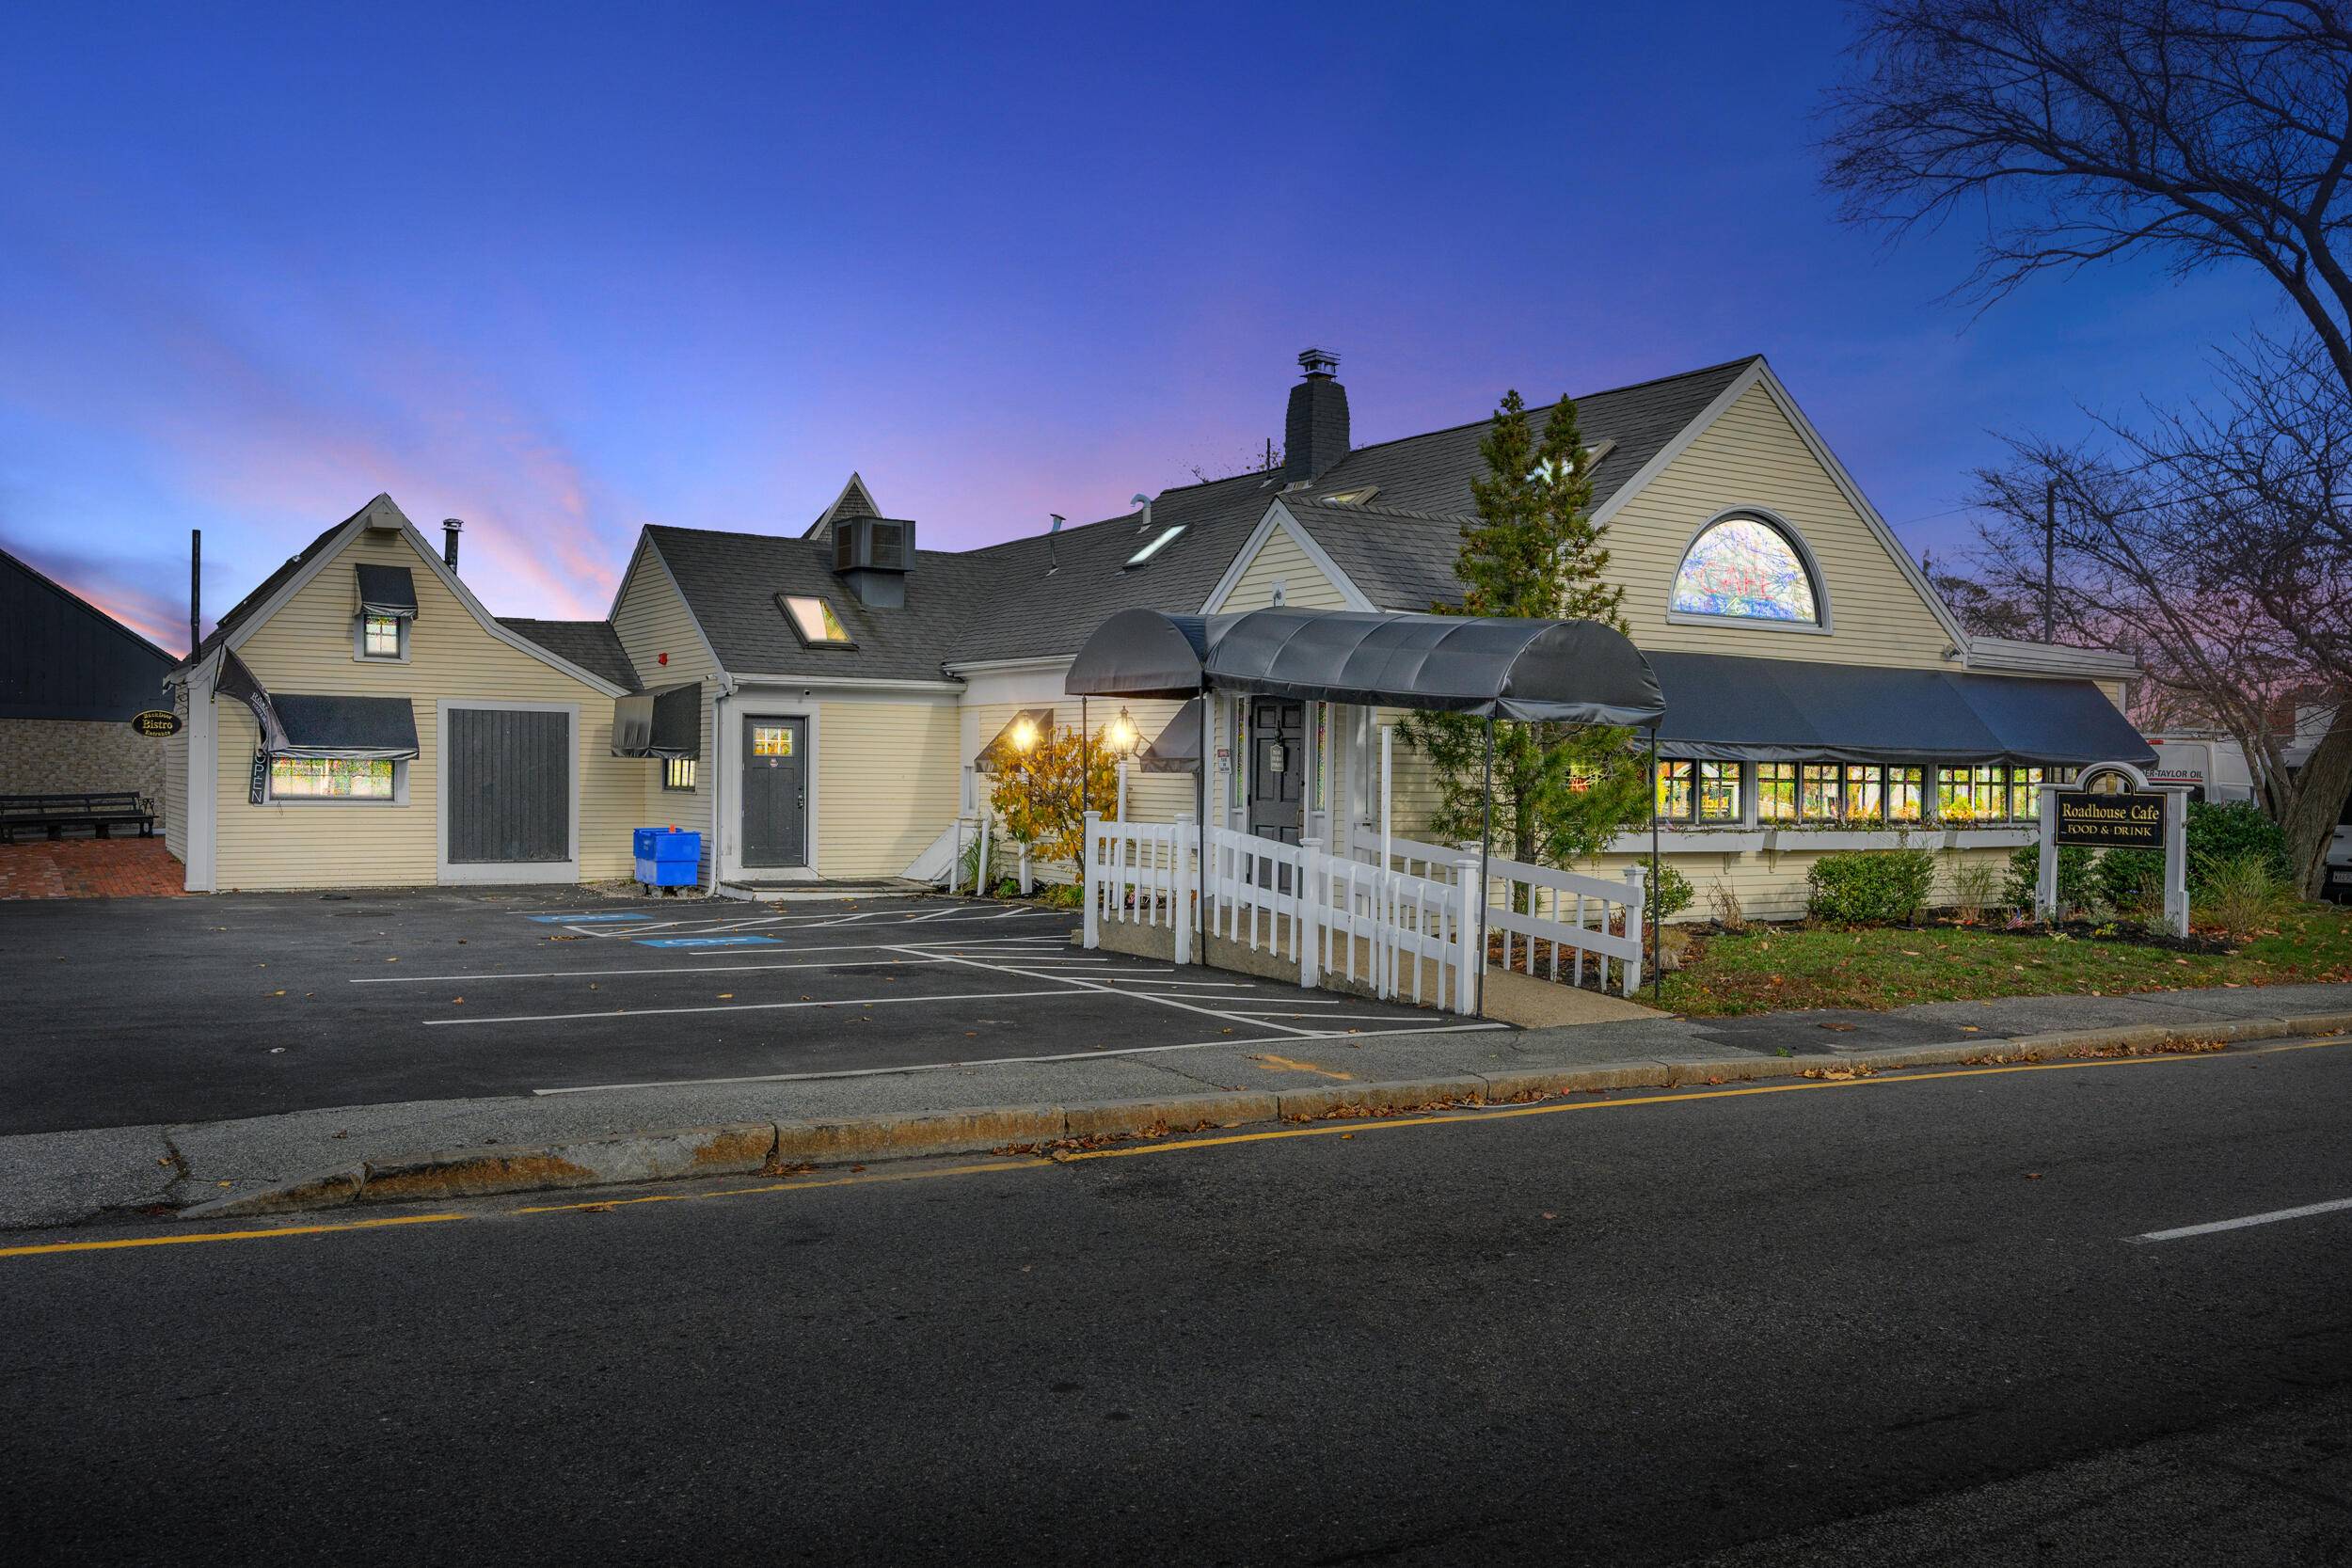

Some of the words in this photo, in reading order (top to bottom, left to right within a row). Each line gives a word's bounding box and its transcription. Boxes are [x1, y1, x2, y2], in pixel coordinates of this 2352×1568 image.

[143, 719, 173, 729] Bistro
[2189, 769, 2203, 779] OIL
[2062, 802, 2126, 819] Roadhouse
[2131, 804, 2159, 820] Cafe
[2068, 824, 2097, 834] FOOD
[2100, 826, 2109, 834] &
[2114, 826, 2153, 836] DRINK
